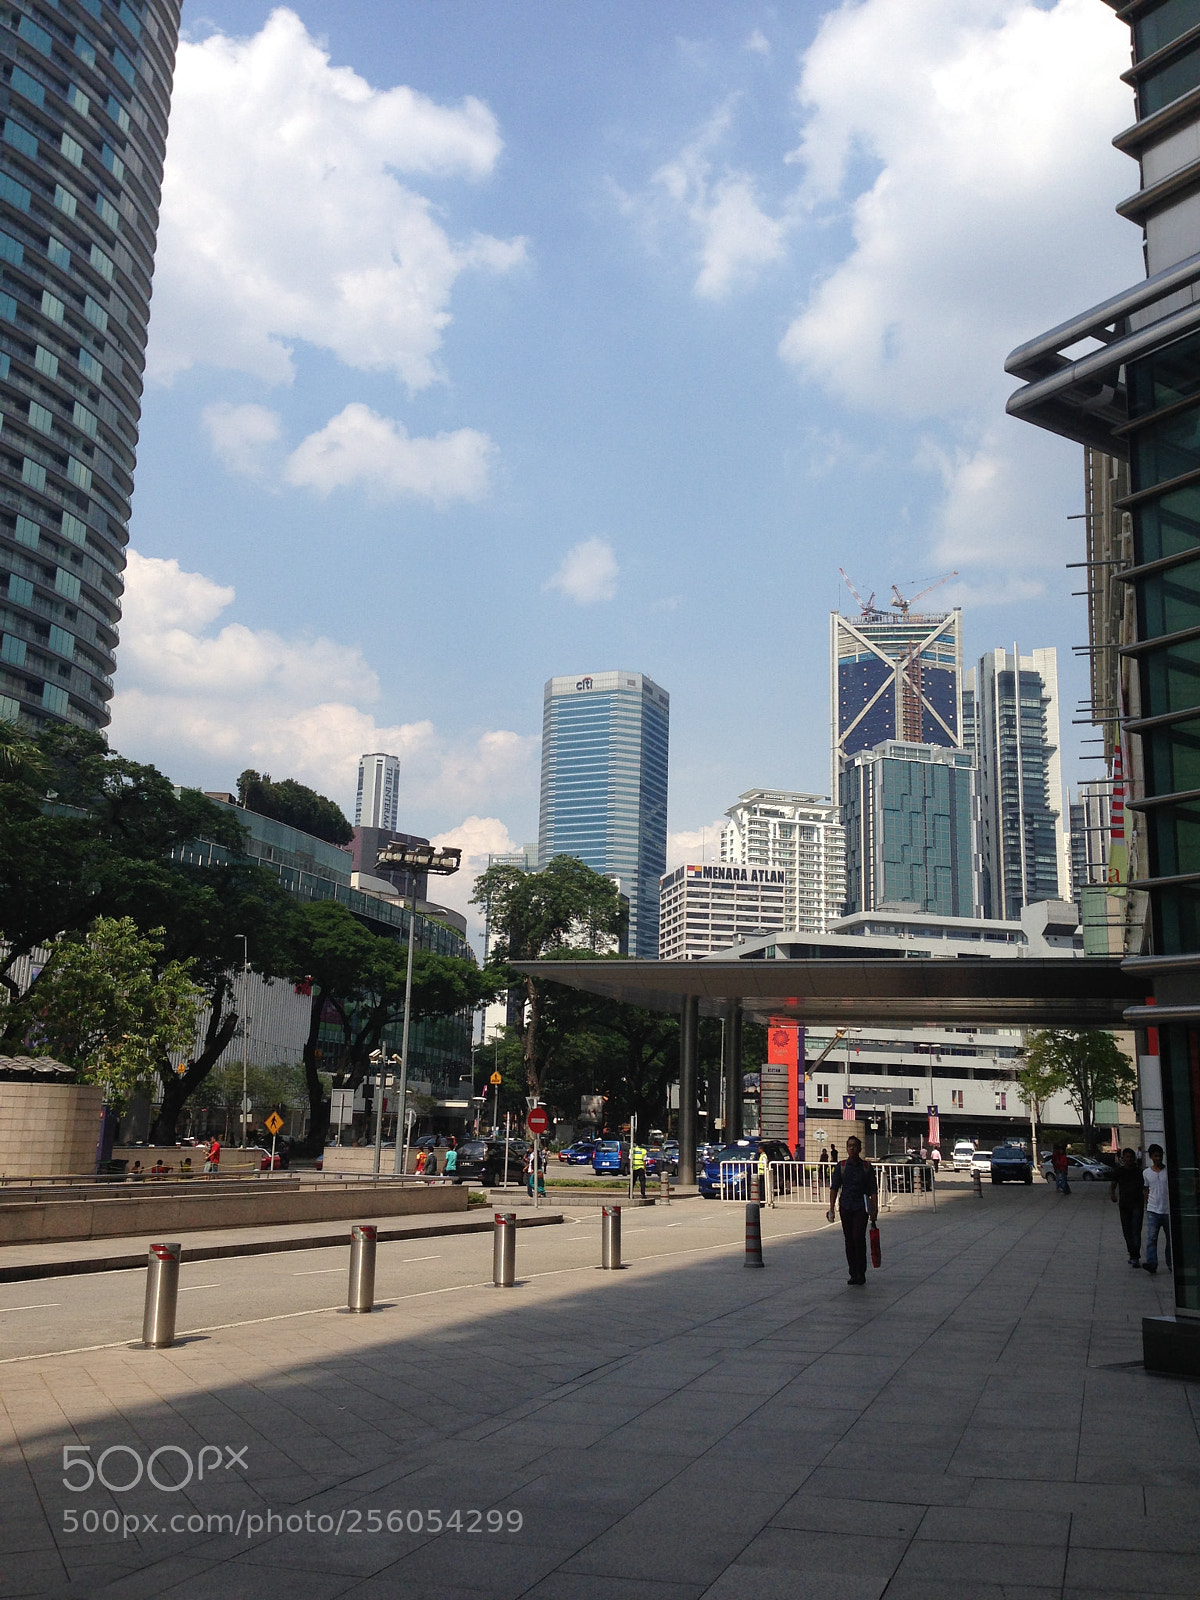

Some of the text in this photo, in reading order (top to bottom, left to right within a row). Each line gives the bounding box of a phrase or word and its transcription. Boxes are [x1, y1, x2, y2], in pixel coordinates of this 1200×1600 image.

[576, 677, 593, 690] citi
[703, 866, 784, 883] MENARA ATLAN
